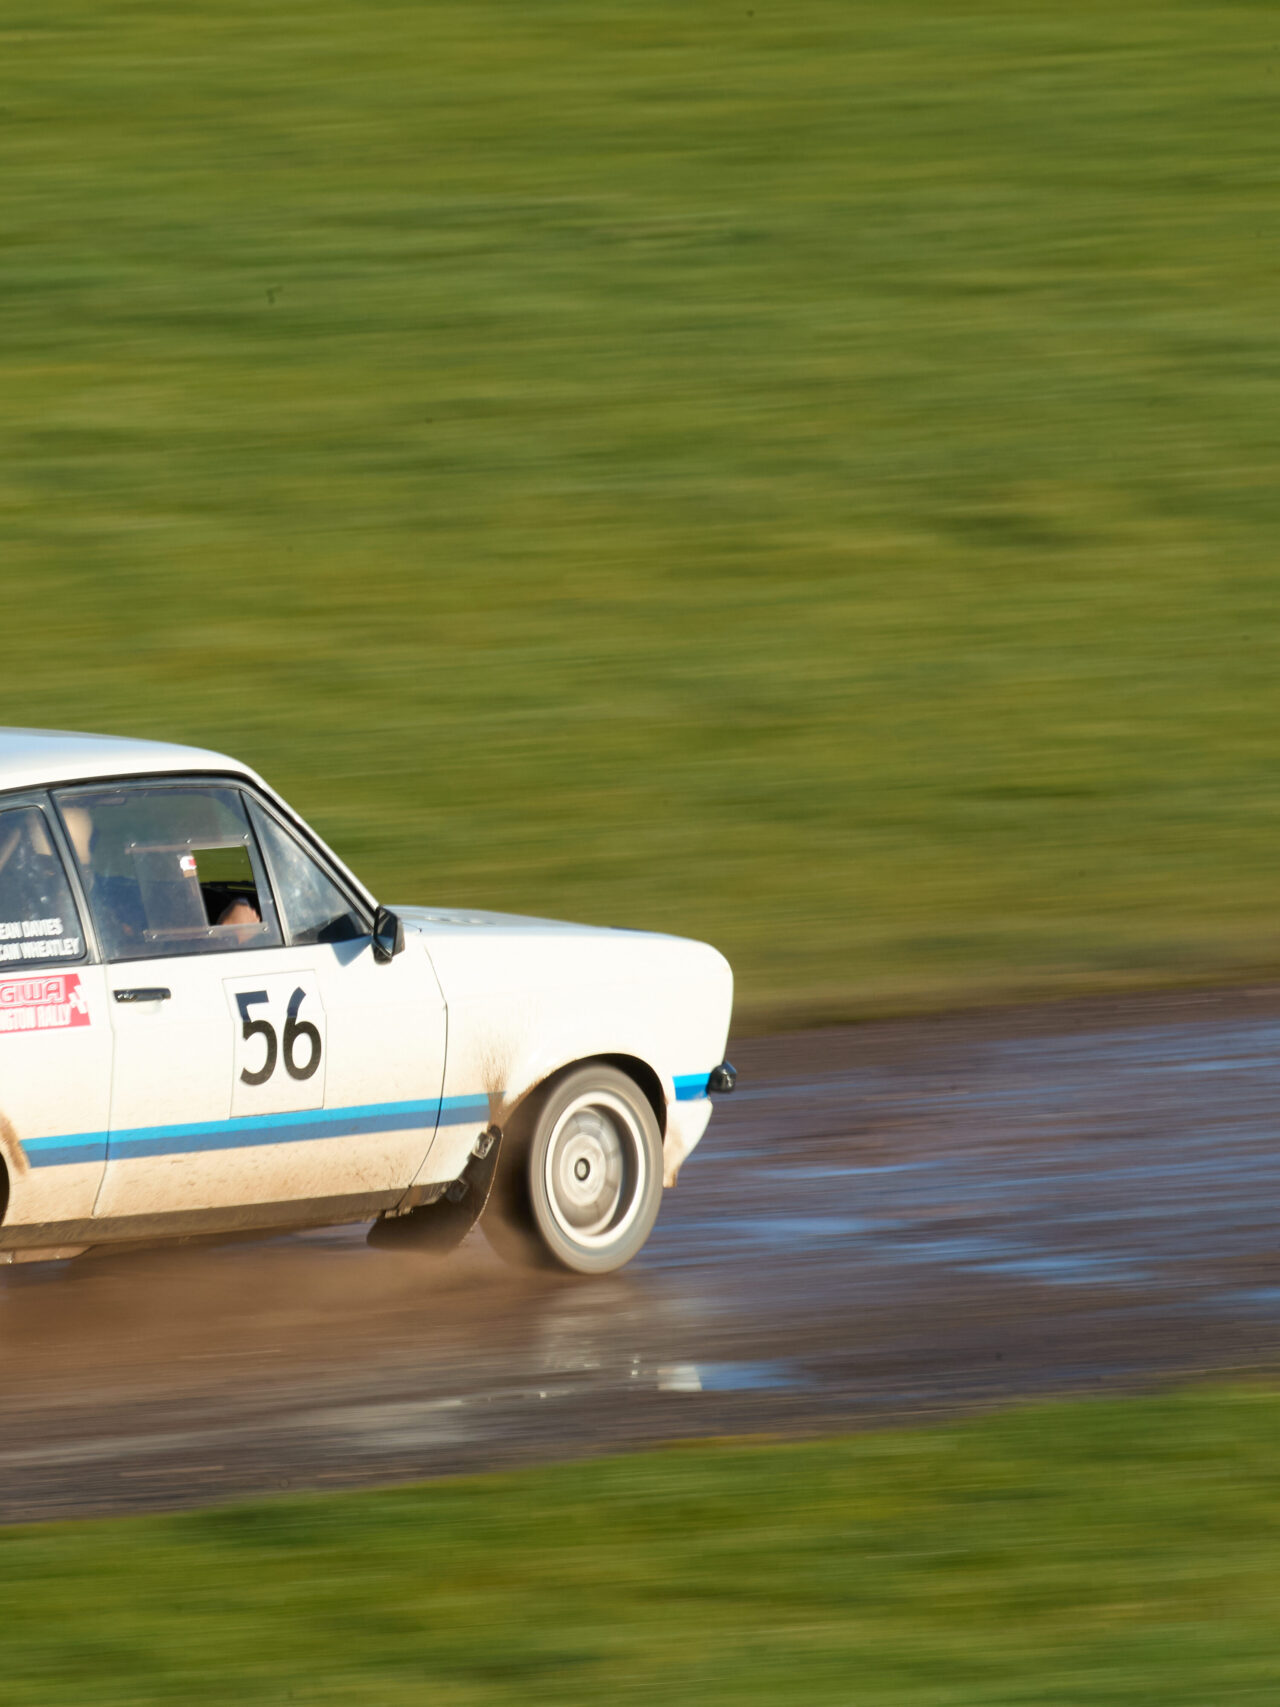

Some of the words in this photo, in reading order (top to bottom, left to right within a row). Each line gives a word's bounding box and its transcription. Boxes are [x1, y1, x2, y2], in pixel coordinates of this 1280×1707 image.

[22, 918, 63, 938] DAVIES
[37, 1003, 71, 1028] RALLY
[234, 986, 322, 1086] 56
